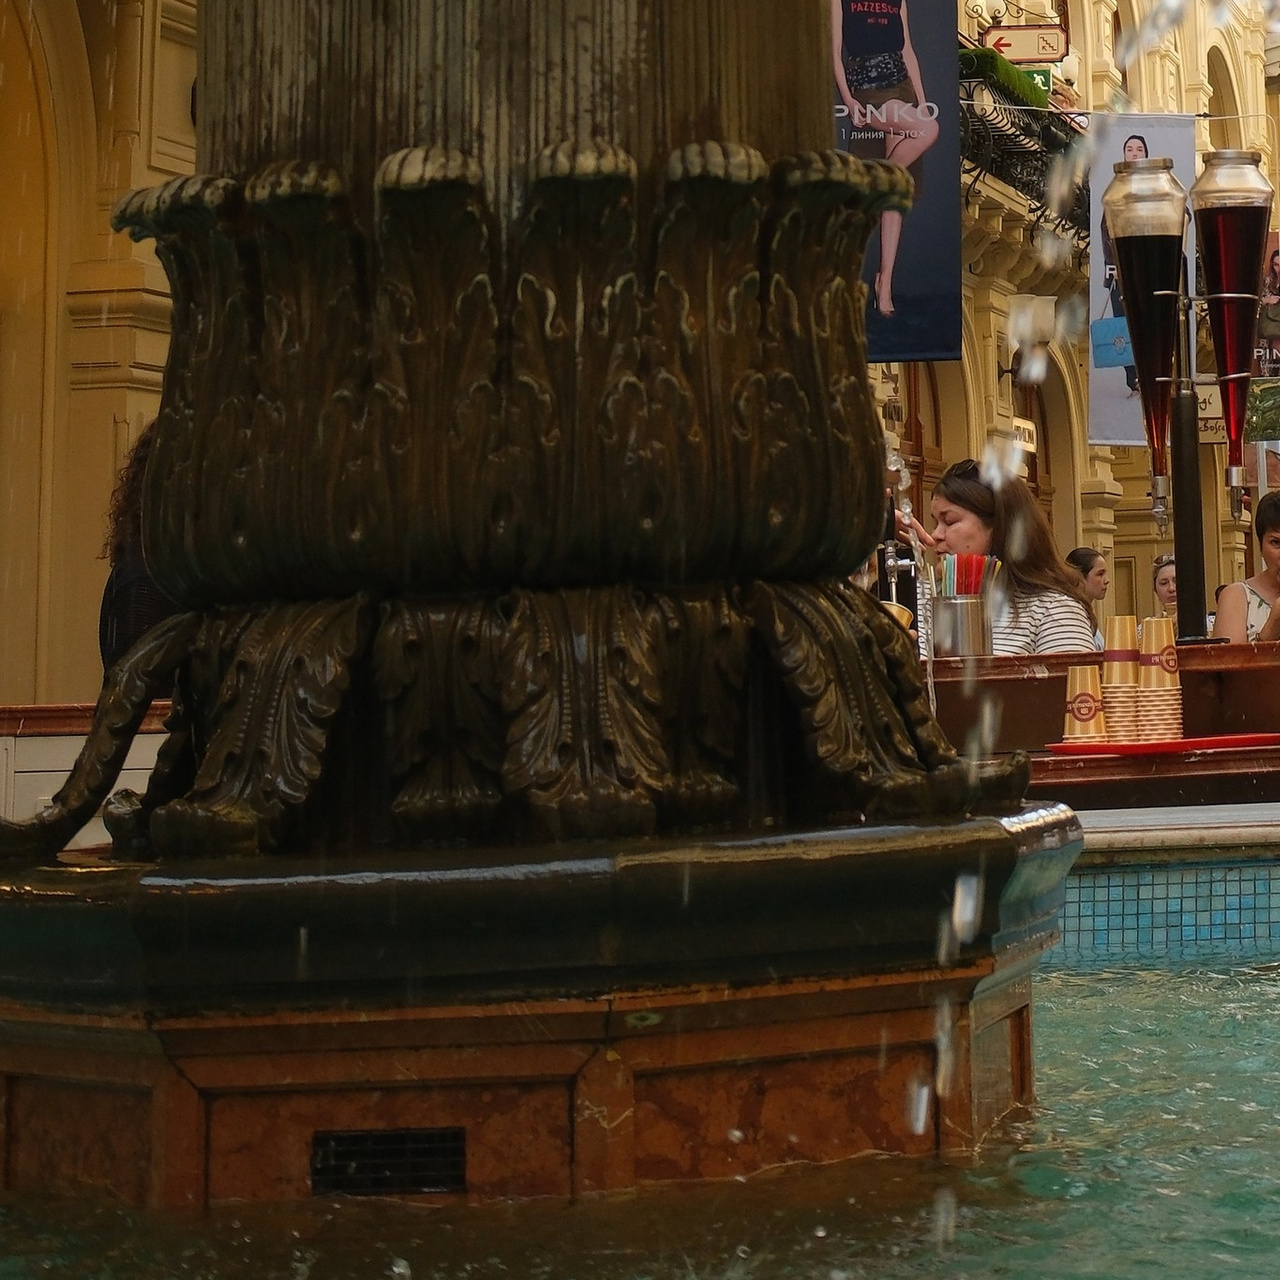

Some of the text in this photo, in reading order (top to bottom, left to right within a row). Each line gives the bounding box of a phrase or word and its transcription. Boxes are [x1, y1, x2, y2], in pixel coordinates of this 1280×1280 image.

[834, 102, 940, 124] PINKO
[840, 128, 846, 140] 1
[850, 130, 885, 140] линия
[889, 127, 894, 139] 1
